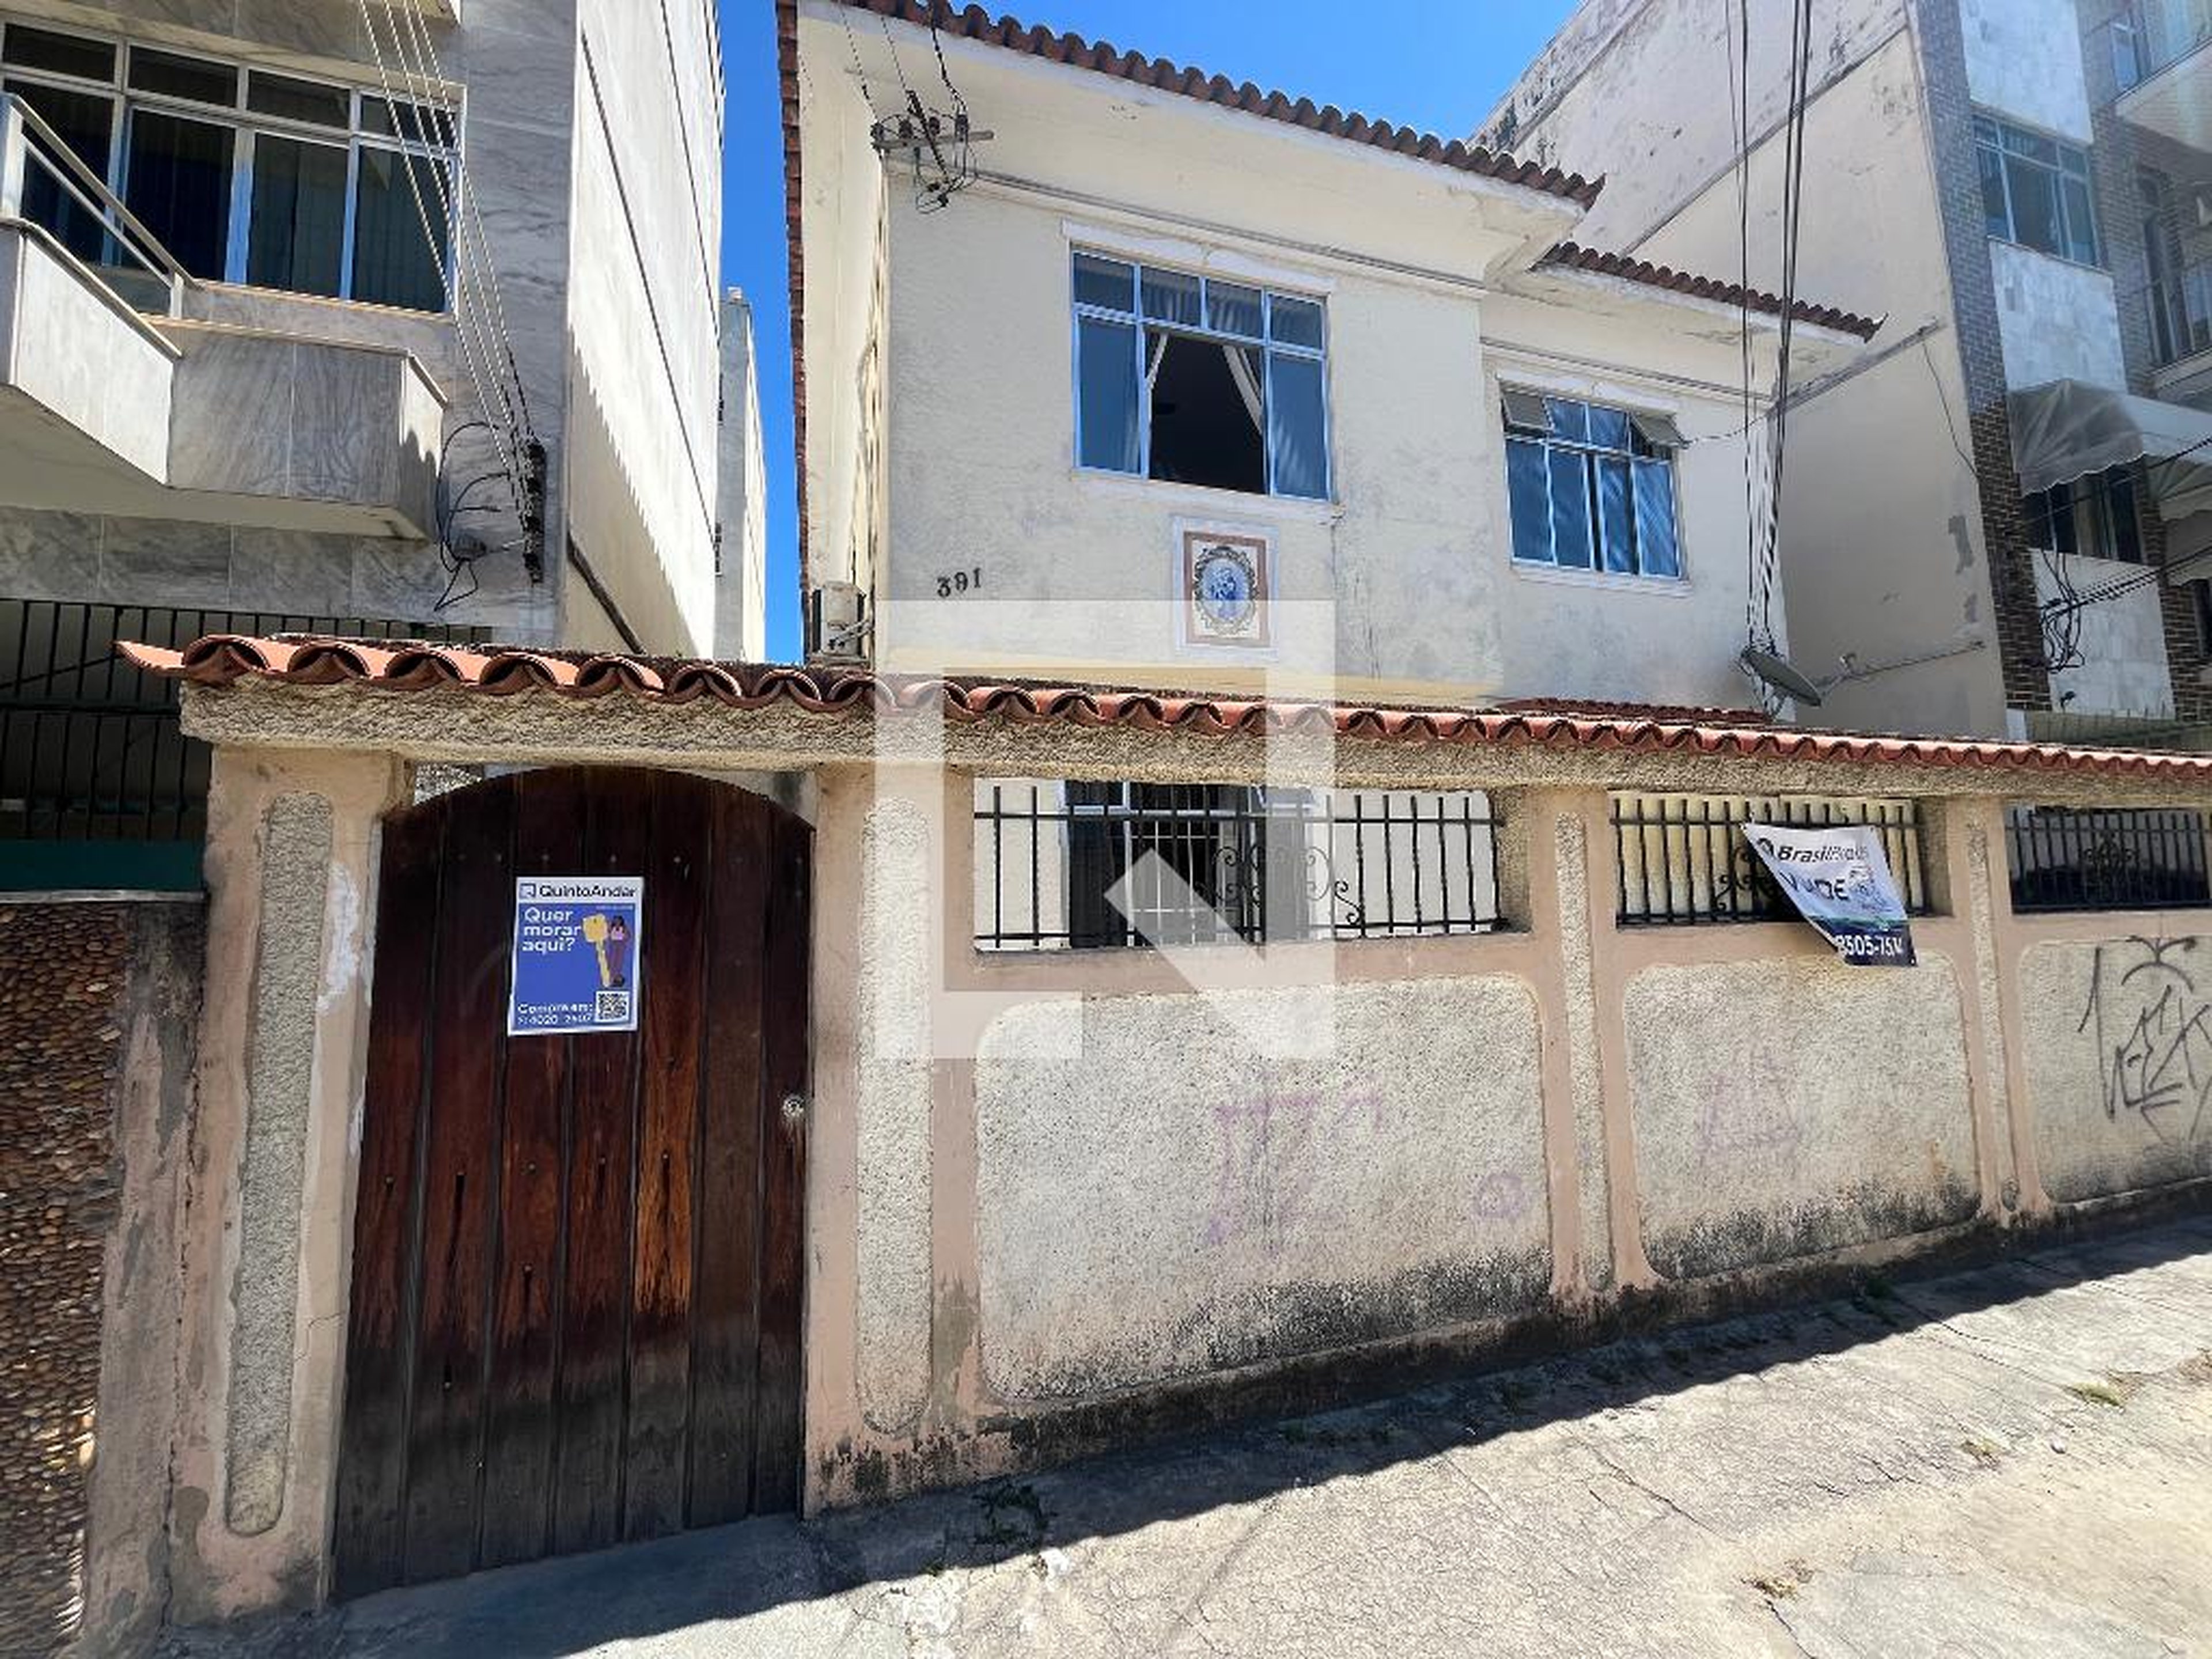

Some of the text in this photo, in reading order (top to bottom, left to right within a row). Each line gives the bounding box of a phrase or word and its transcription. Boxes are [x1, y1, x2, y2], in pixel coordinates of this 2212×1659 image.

[937, 567, 982, 598] 391
[539, 884, 636, 897] QuintoAndar
[524, 907, 573, 923] Quer
[524, 925, 581, 937] morar
[522, 937, 575, 955] aqui?
